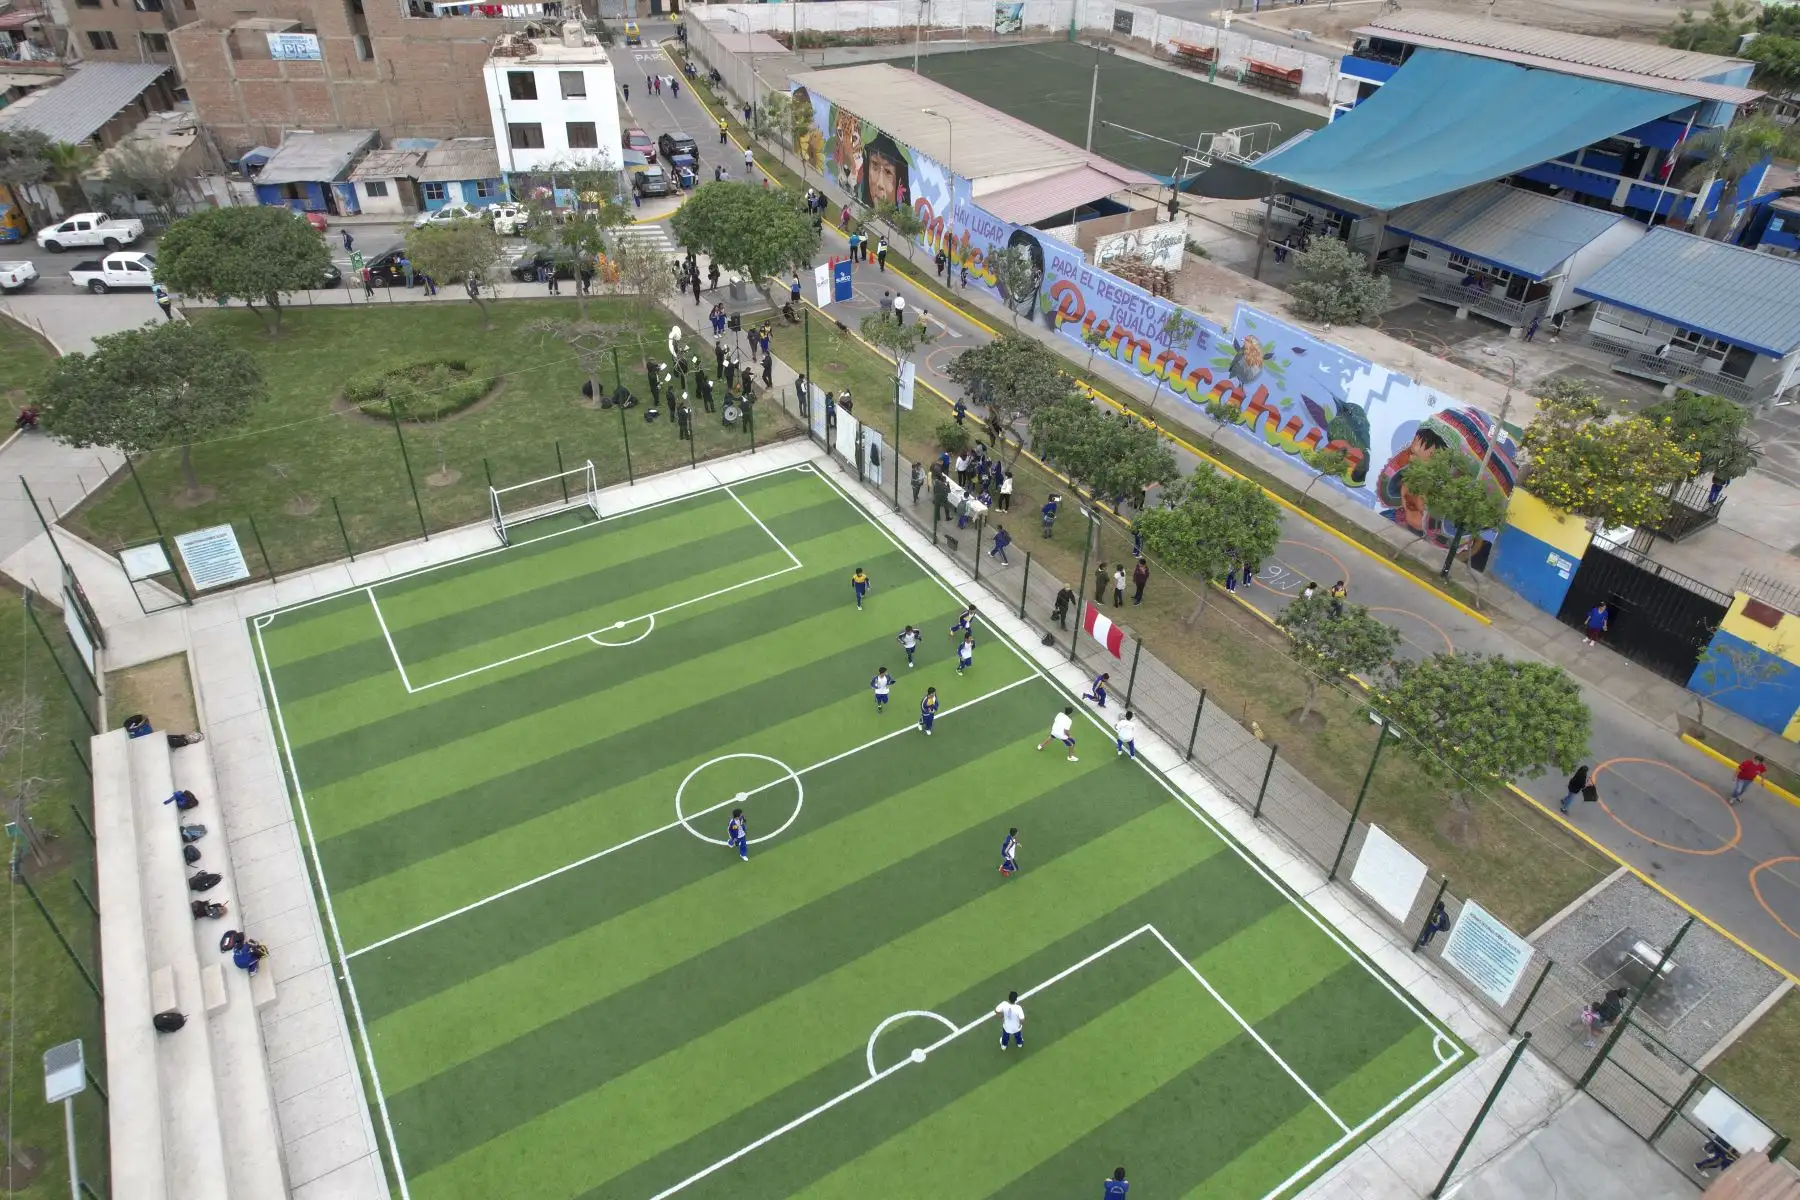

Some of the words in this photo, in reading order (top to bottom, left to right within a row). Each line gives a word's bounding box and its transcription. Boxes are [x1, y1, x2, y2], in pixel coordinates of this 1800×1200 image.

[953, 205, 970, 226] HAY
[972, 215, 1004, 244] LUGAR
[1051, 255, 1078, 281] PARA
[1079, 271, 1095, 290] EL
[1197, 329, 1211, 351] E
[1108, 304, 1172, 349] IGUALDAD
